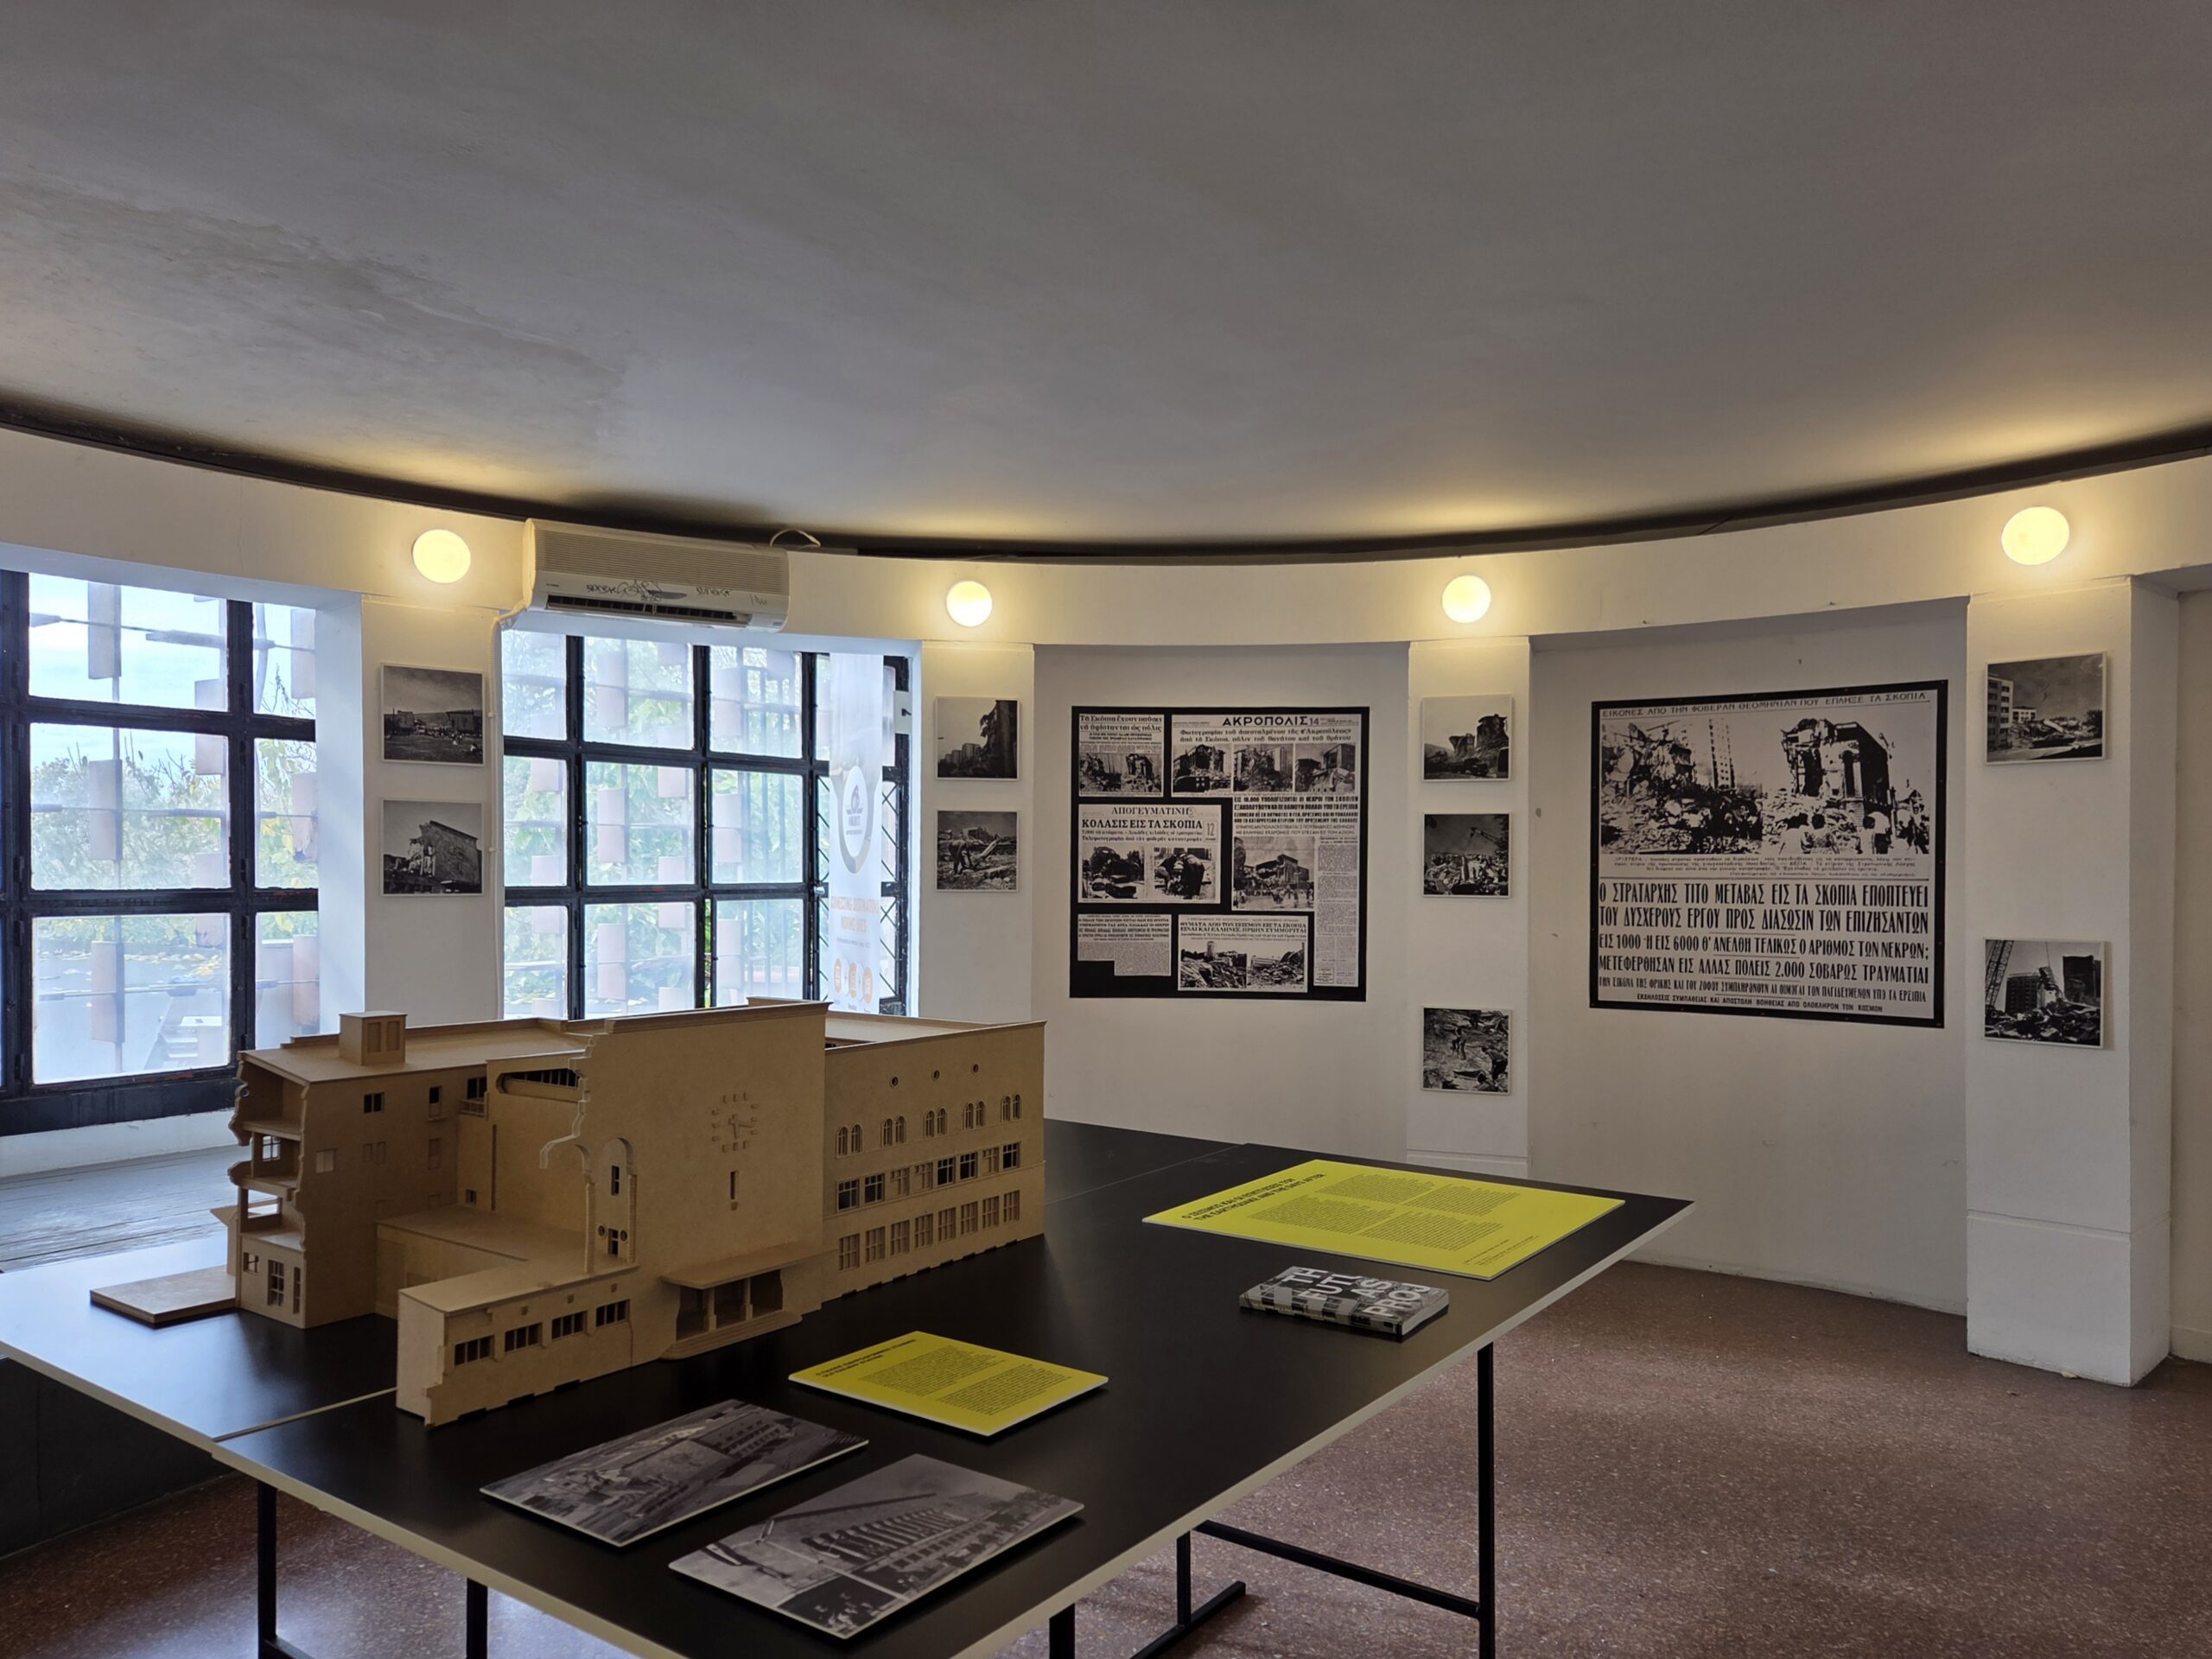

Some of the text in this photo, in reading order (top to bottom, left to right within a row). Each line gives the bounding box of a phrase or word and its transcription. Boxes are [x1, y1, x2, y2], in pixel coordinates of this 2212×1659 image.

[1603, 709, 1643, 717] ΕΙΚΟΝΕΣ
[1691, 703, 1735, 713] ΦΟΒΕΡΑΝ
[1222, 716, 1308, 727] ΑΚΡΟΠΟΛΙΣ
[1112, 806, 1189, 815] ΑΠΟΓΕΥΜΑΤΙΝΗ
[1082, 819, 1203, 829] ΚΟΛΑΣΙΣ ΕΙΣ ΤΑ ΣΚΟΠΙΑ
[1206, 823, 1215, 836] 12
[1599, 883, 1928, 907] Ο ΣΤΡΑΤΑΡΧΗΣ ΤΙΤΟ ΜΕΤΑΒΑΣ ΕΙΣ ΤΑ ΣΚΟΠΙΑ ΕΠΟΠΤΕΥΕΙ
[1600, 906, 1929, 934] ΤΟΥ ΔΥΣΧΕΡΟΥΣ ΕΡΓΟΥ ΠΡΟΣ ΔΙΑΣΩΣΙΝ ΤΩΝ ΕΠΙΖΗΣΑΝΤΩΝ
[1599, 933, 1613, 949] ΕΙΣ
[1617, 934, 1641, 950] 1000
[1656, 935, 1670, 950] ΕΙΣ
[1673, 936, 1699, 951] 6000
[1713, 937, 1751, 953] ΑΝΕΛΘΗ
[1755, 938, 1796, 955] ΤΕΛΙΚΩΣ
[1799, 939, 1807, 955] Ο
[1808, 939, 1855, 957] ΑΡΙΘΜΟΣ
[1858, 940, 1878, 957] ΤΩΝ
[1881, 941, 1929, 961] ΝΕΚΡΩΝ;
[1599, 955, 1929, 984] ΜΕΤΕΦΕΡΘΗΣΑΝ ΕΙΣ ΑΛΛΑΣ ΠΟΛΕΙΣ 2.000 ΣΟΒΑΡΩΣ ΤΡΑΥΜΑΤΙΑΙ
[1686, 980, 1697, 990] ΤΟΥ
[1351, 1279, 1392, 1299] AS
[1363, 1282, 1431, 1317] PROJ
